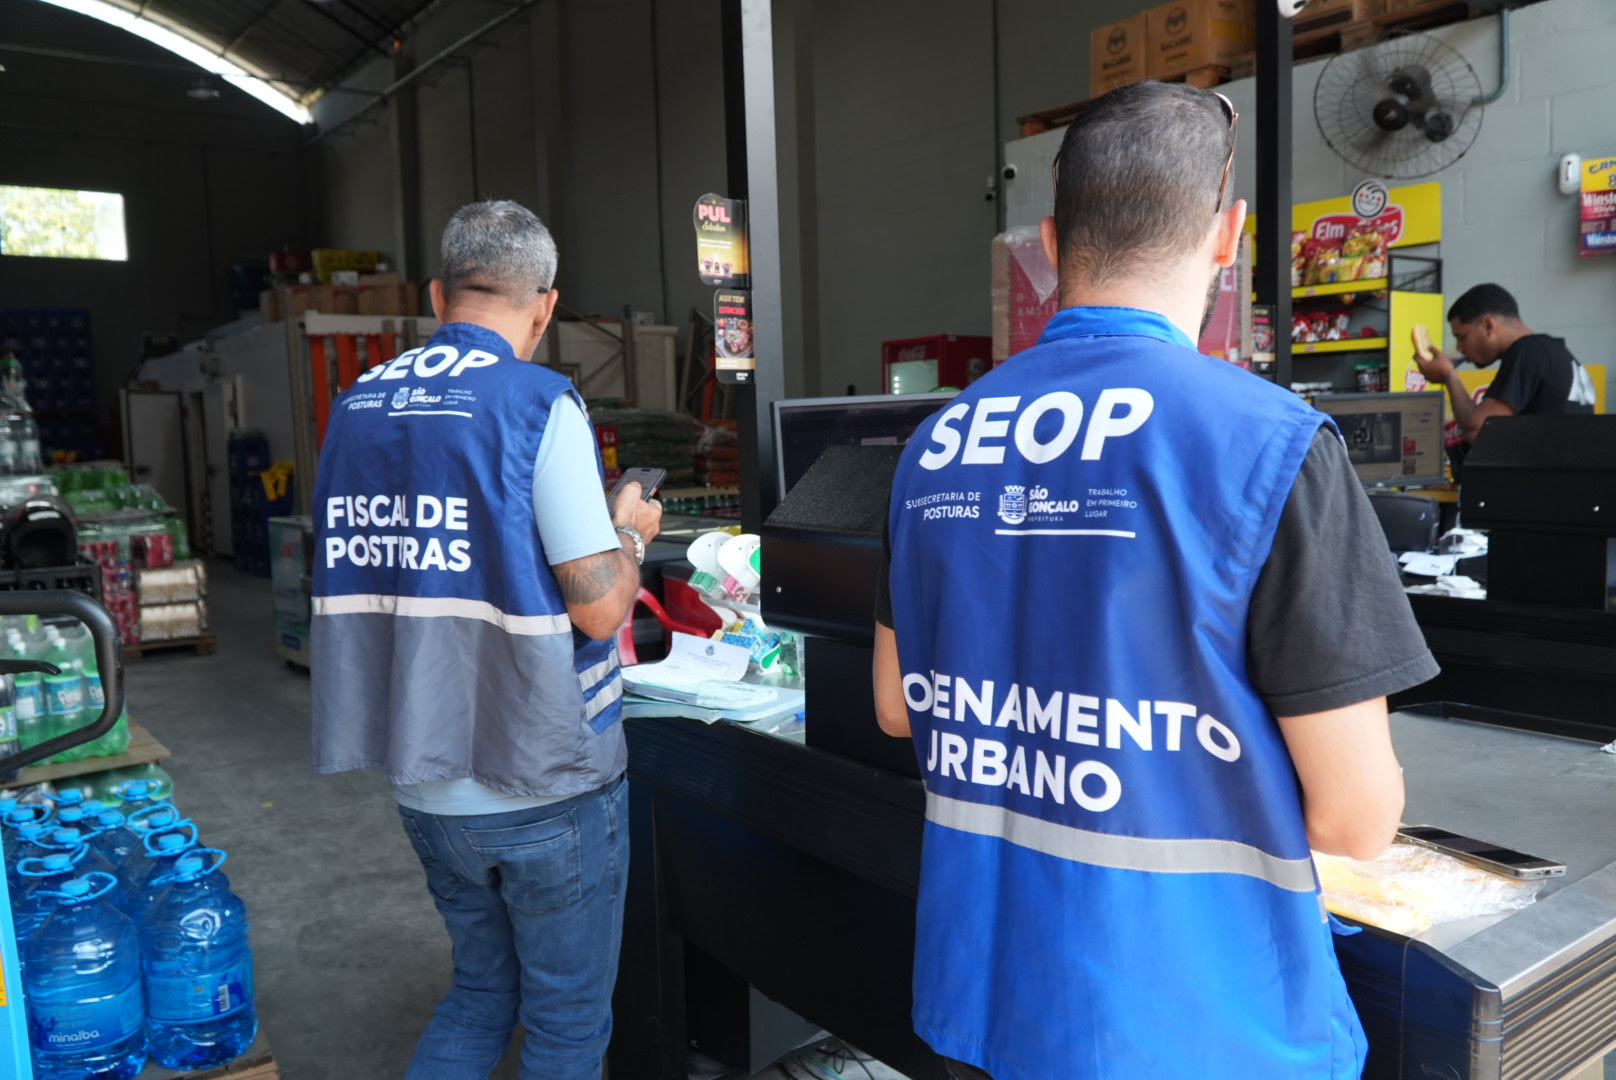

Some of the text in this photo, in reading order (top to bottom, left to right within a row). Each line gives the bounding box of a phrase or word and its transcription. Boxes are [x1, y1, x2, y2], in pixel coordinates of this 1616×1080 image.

[1316, 221, 1346, 240] Elm
[357, 345, 500, 384] SEOP
[919, 388, 1154, 470] SEOP
[1029, 485, 1048, 500] SÃO
[1088, 488, 1128, 496] TRABALHO
[906, 491, 981, 510] SUBSECRETARIA DE
[1029, 500, 1079, 514] GONÇALO
[1086, 499, 1138, 509] EM PRIMEIRO
[327, 494, 468, 531] FISCAL DE
[923, 505, 980, 521] POSTURAS
[1085, 510, 1108, 518] LUGAR
[902, 669, 1241, 763] OENAMENTO
[48, 1029, 100, 1043] minalba
